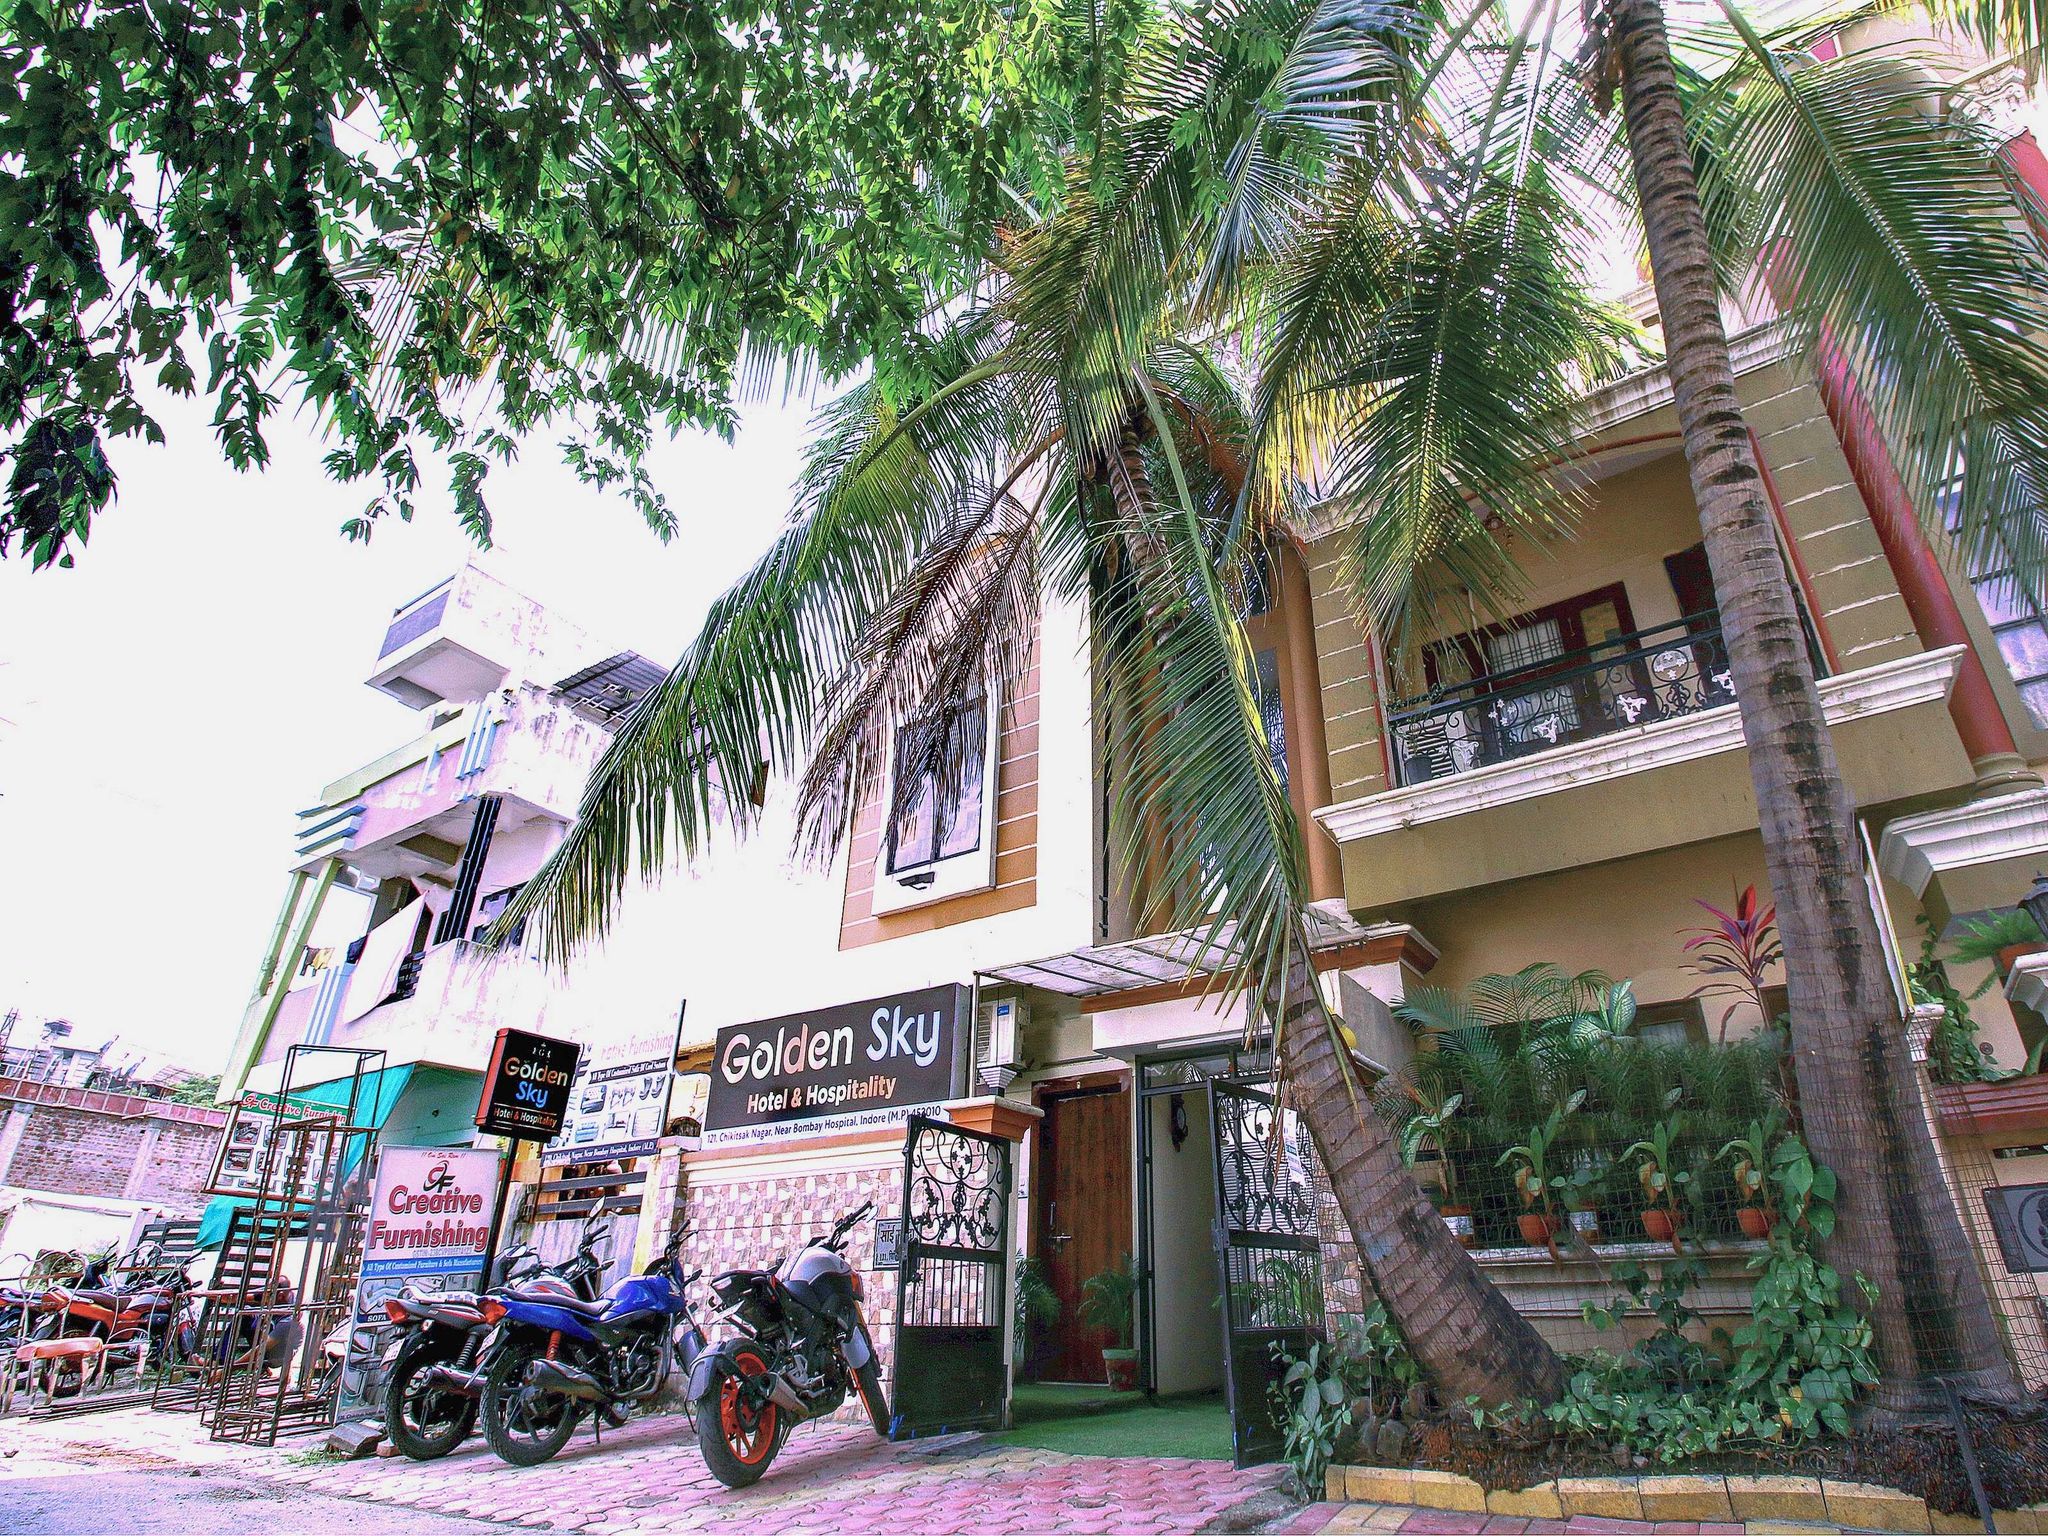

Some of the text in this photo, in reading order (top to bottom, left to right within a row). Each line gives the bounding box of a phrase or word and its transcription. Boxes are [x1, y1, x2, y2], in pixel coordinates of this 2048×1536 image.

[720, 1005, 941, 1084] Golden Sky
[505, 1056, 568, 1087] Golden
[516, 1081, 548, 1108] Sky
[747, 1074, 897, 1114] Hotel & Hospitality
[494, 1107, 557, 1128] Hotel & Hospitality
[774, 1125, 791, 1136] Near
[793, 1120, 823, 1134] Bombay
[860, 1114, 886, 1125] Indore
[388, 1184, 483, 1214] Creative
[368, 1219, 490, 1252] Furnishing
[367, 1314, 387, 1322] SOFA
